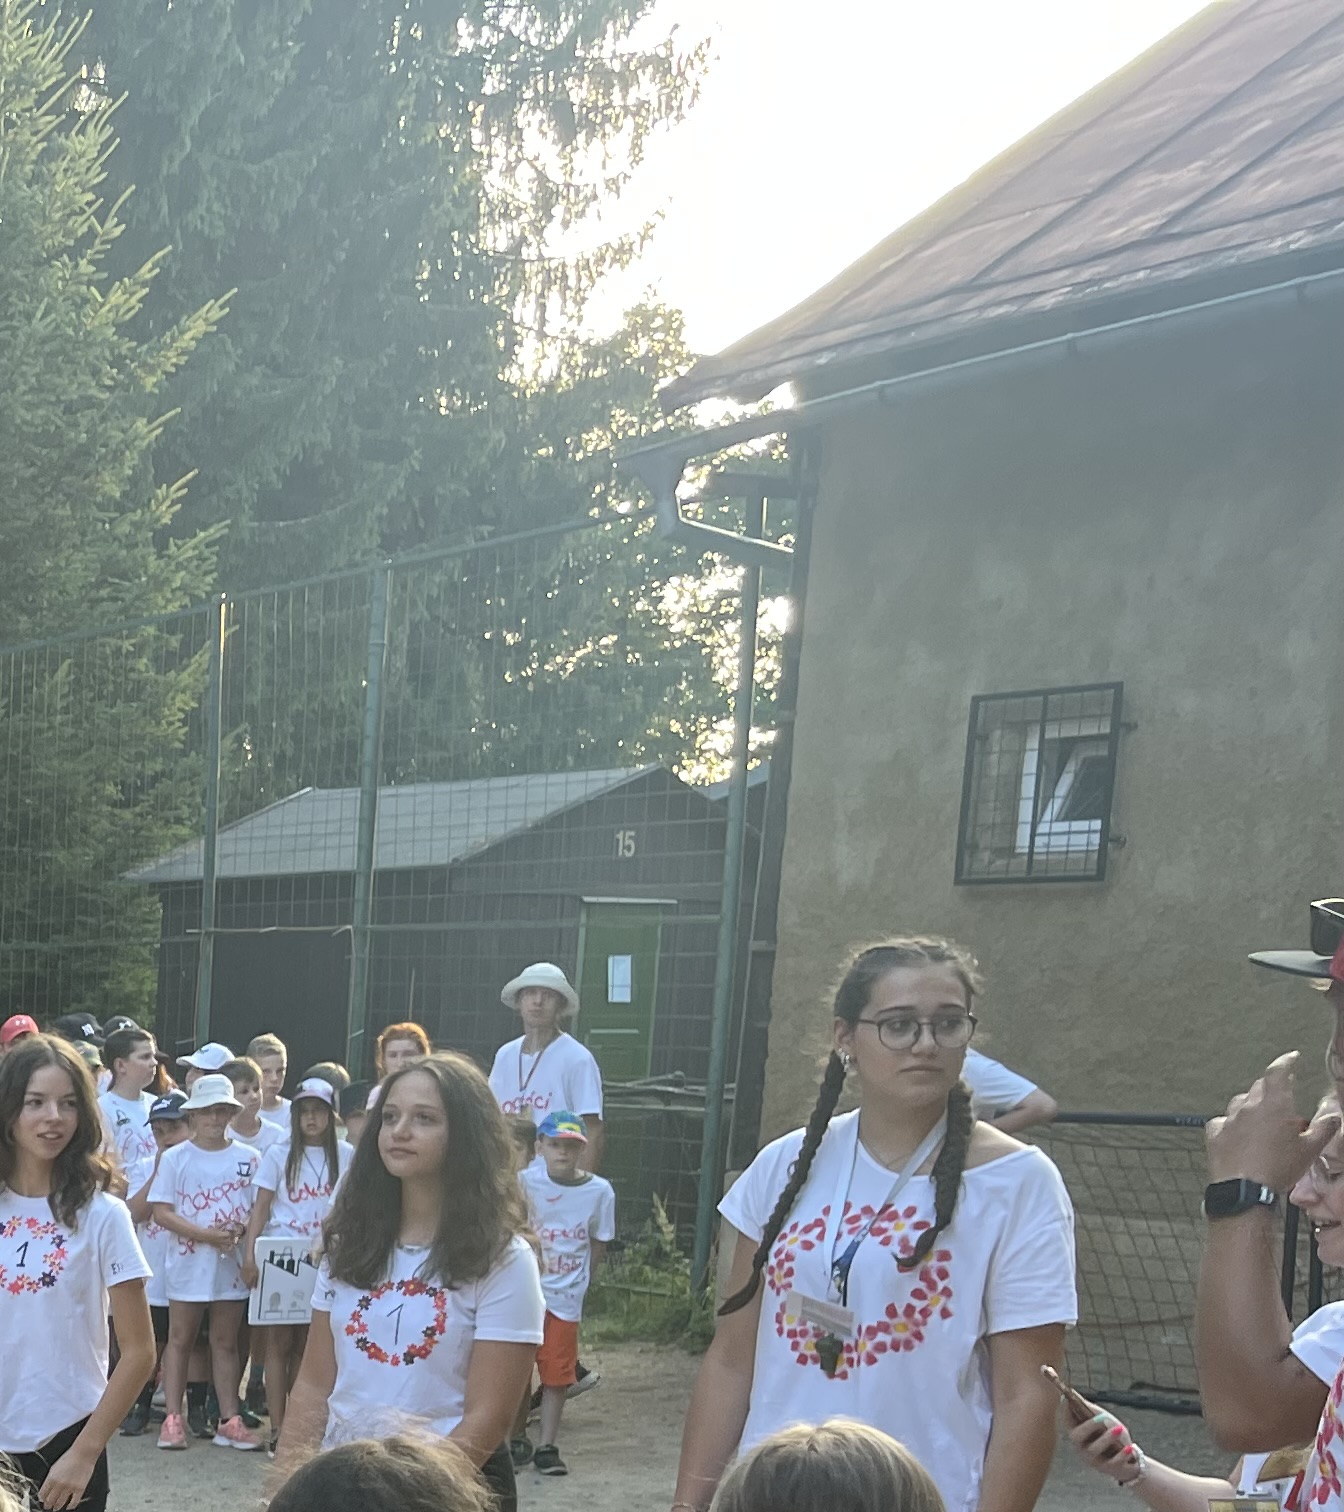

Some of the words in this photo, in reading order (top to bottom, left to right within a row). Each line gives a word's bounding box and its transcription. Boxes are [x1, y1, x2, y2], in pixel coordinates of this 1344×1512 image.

[616, 831, 636, 858] 15
[16, 1240, 30, 1268] 1
[386, 1303, 405, 1346] 1
